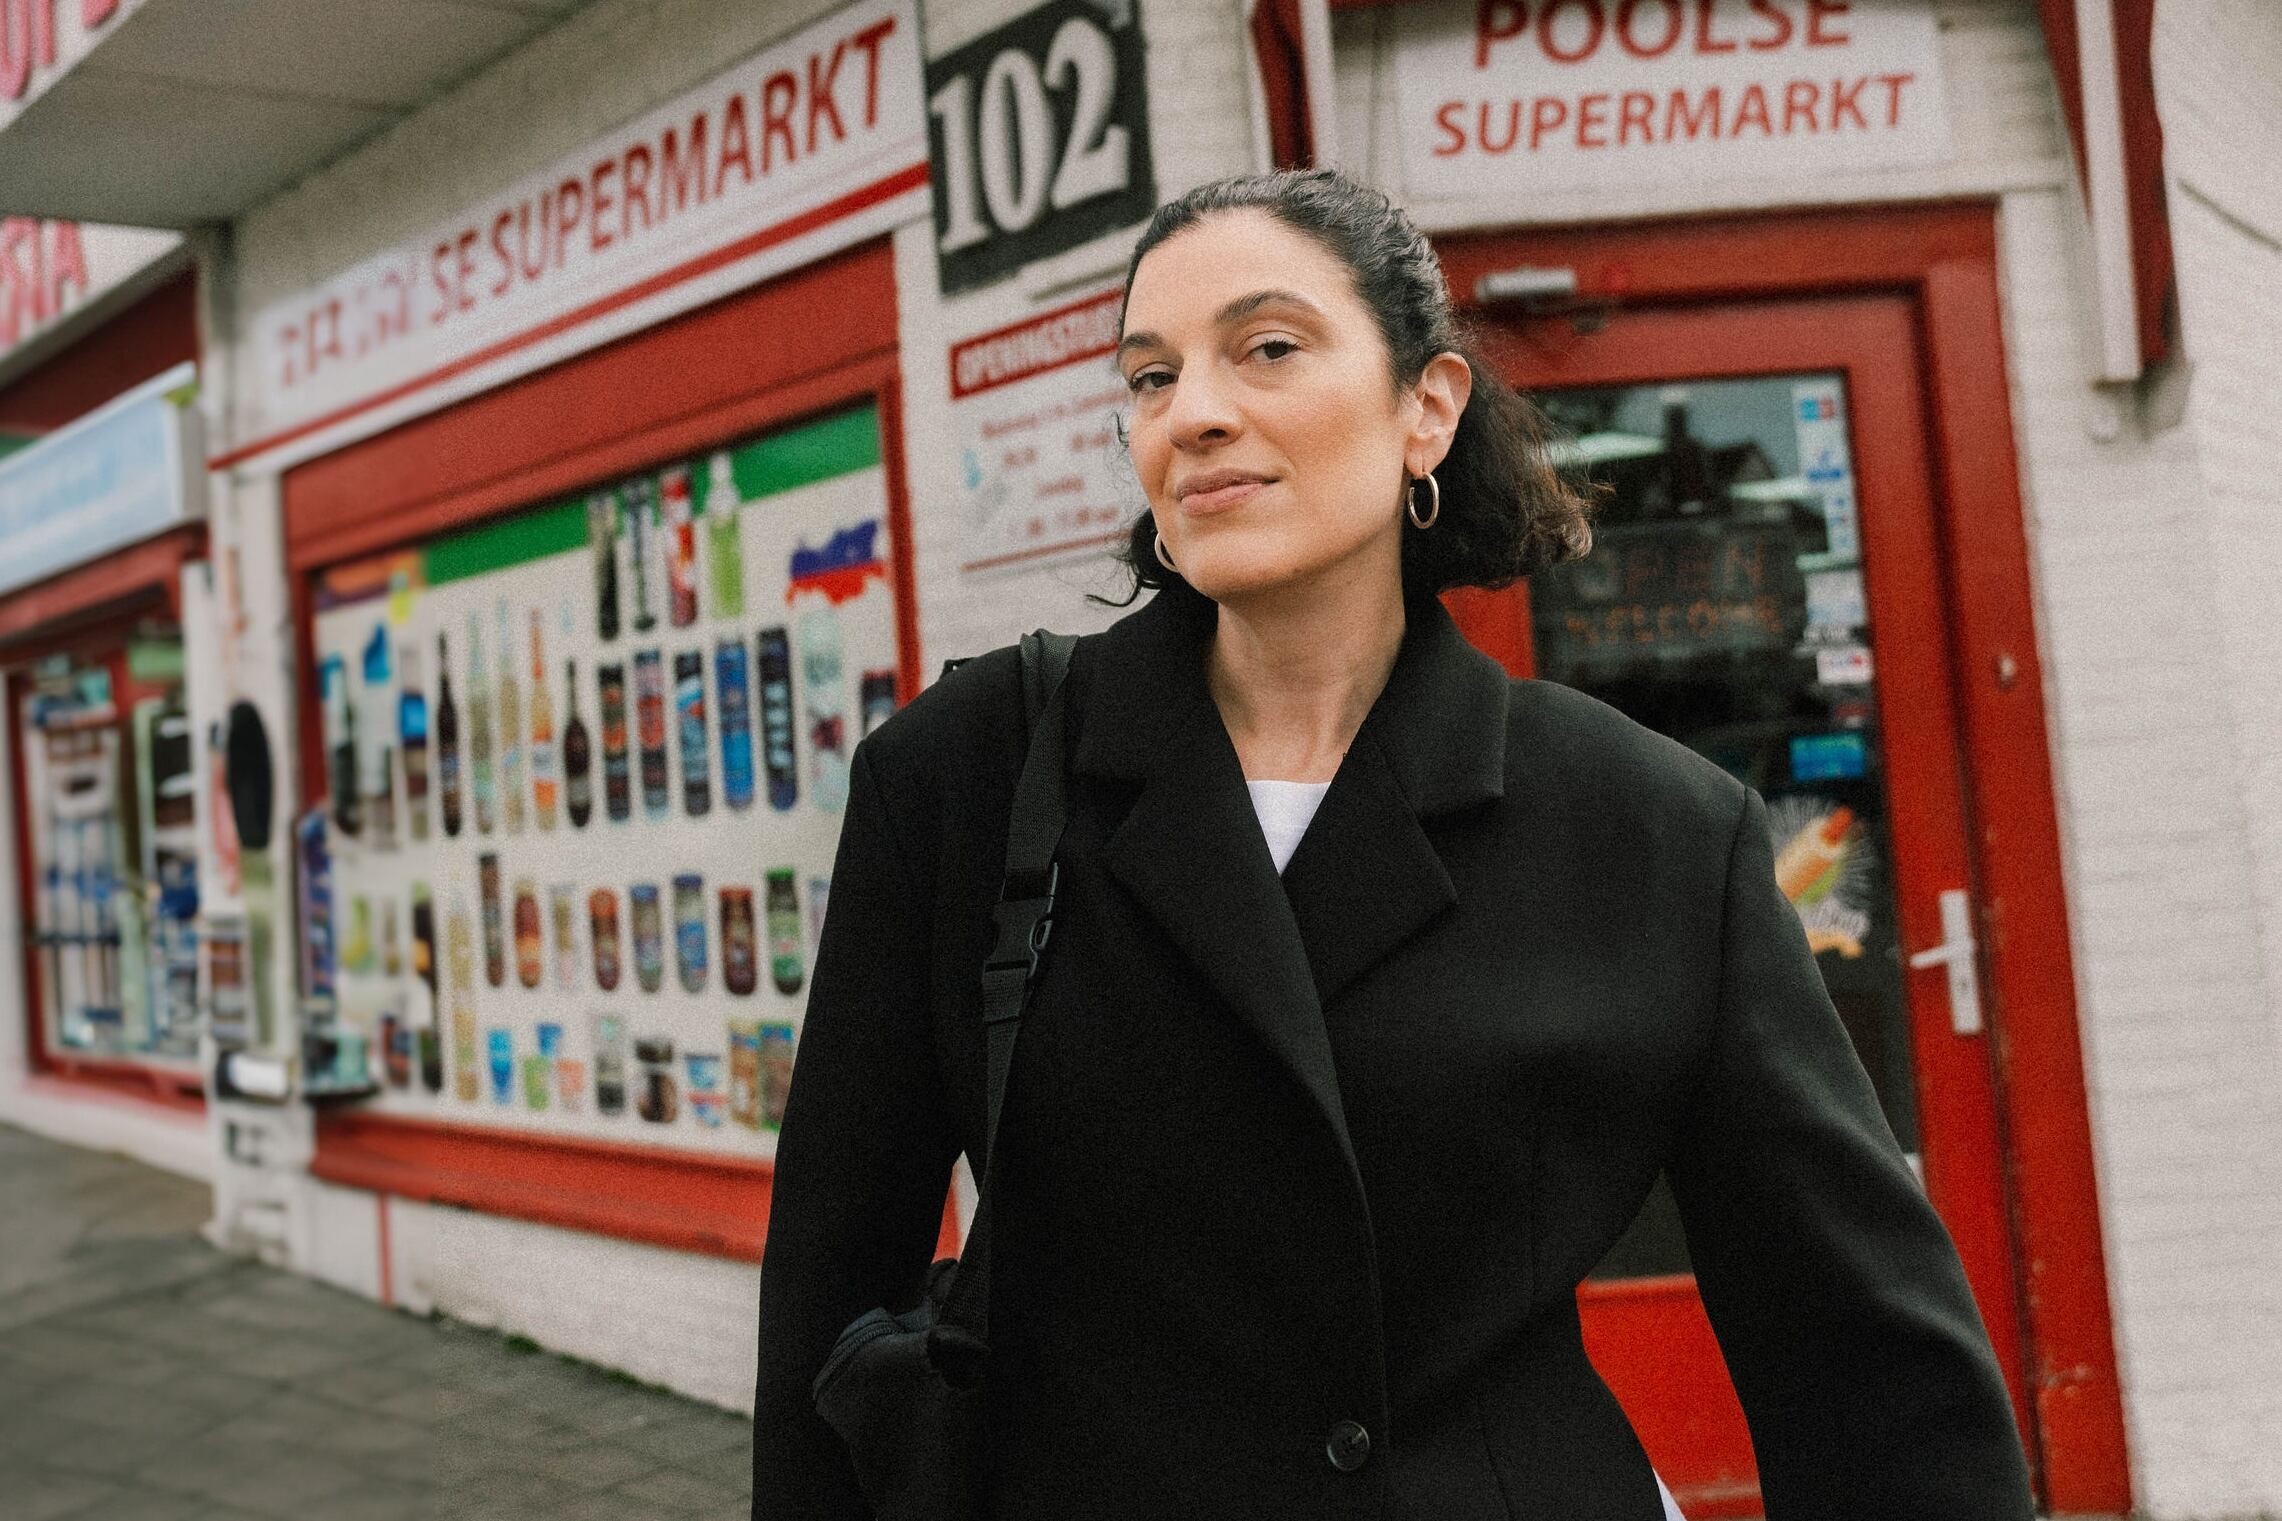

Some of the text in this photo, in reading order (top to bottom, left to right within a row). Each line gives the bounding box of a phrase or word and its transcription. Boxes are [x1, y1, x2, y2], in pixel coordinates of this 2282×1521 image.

[1432, 72, 1915, 158] SUPERMARKT
[1474, 0, 1852, 70] POOLSE
[489, 16, 899, 298] SUPERMARKT
[931, 18, 1132, 252] 102
